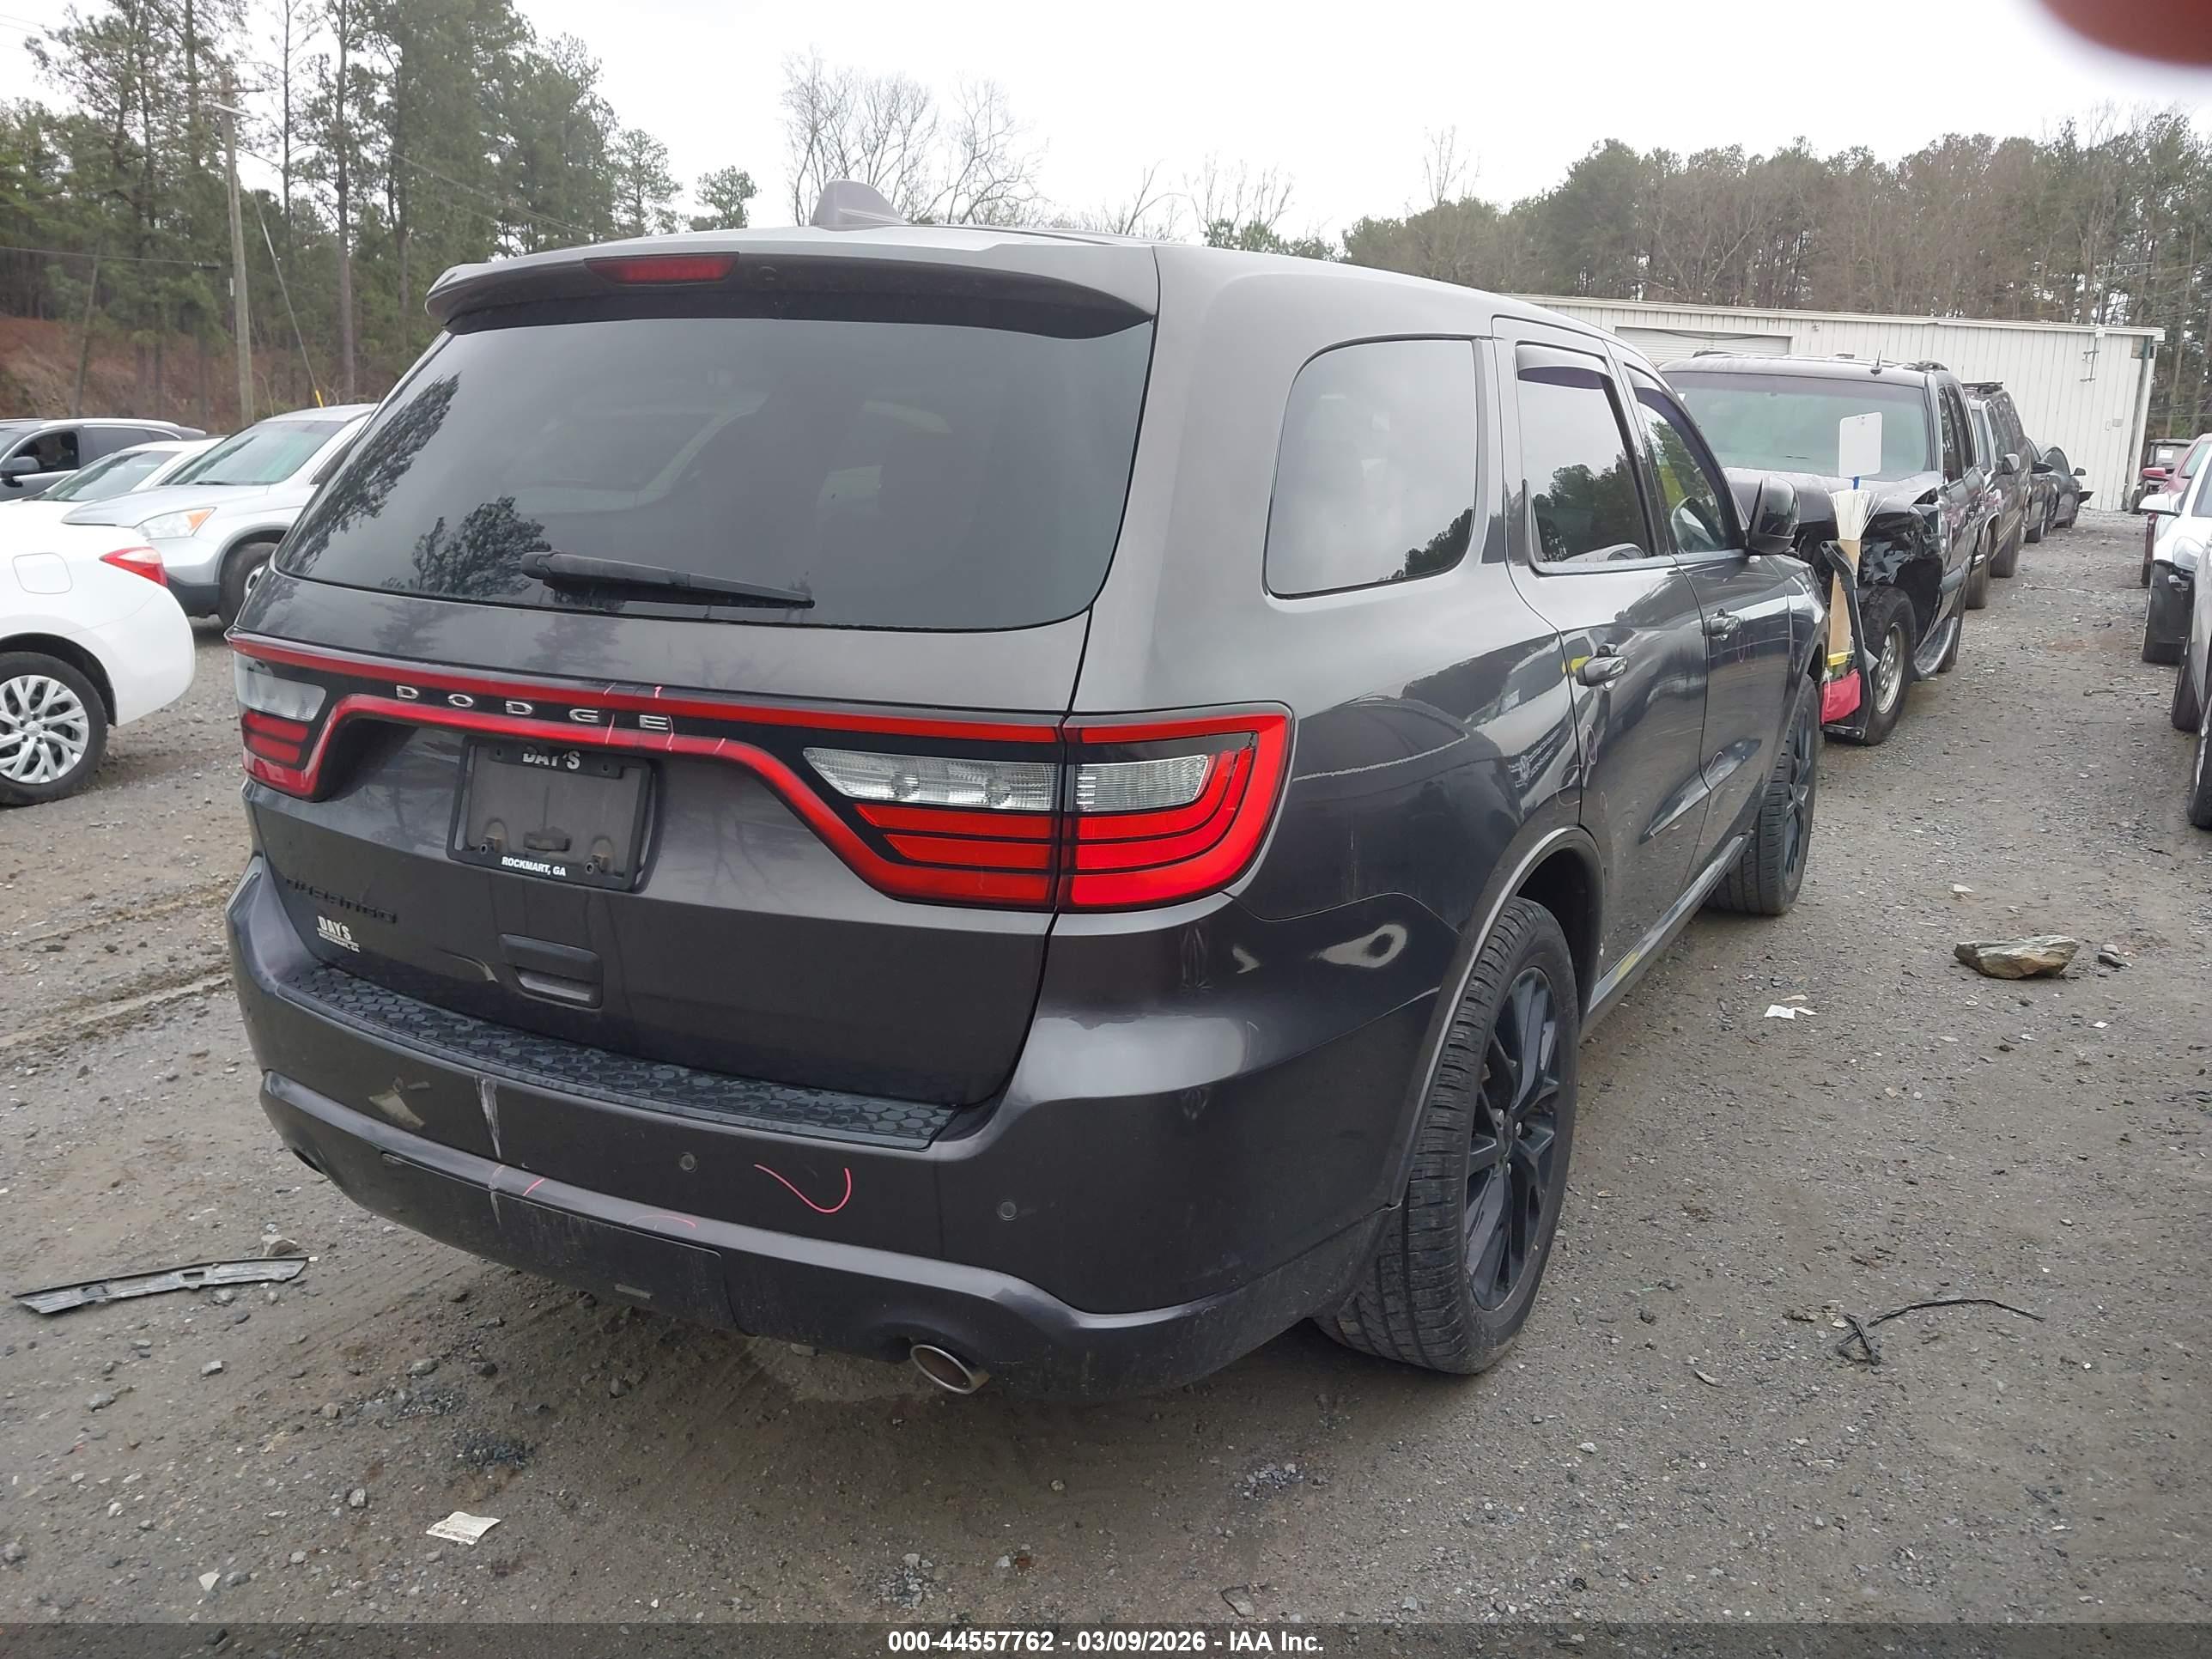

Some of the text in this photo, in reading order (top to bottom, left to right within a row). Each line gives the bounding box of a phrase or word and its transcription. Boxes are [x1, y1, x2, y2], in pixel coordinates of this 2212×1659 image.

[396, 684, 669, 731] DODGE
[501, 856, 566, 877] ROCKMART, GA
[317, 915, 352, 940] DAY'S
